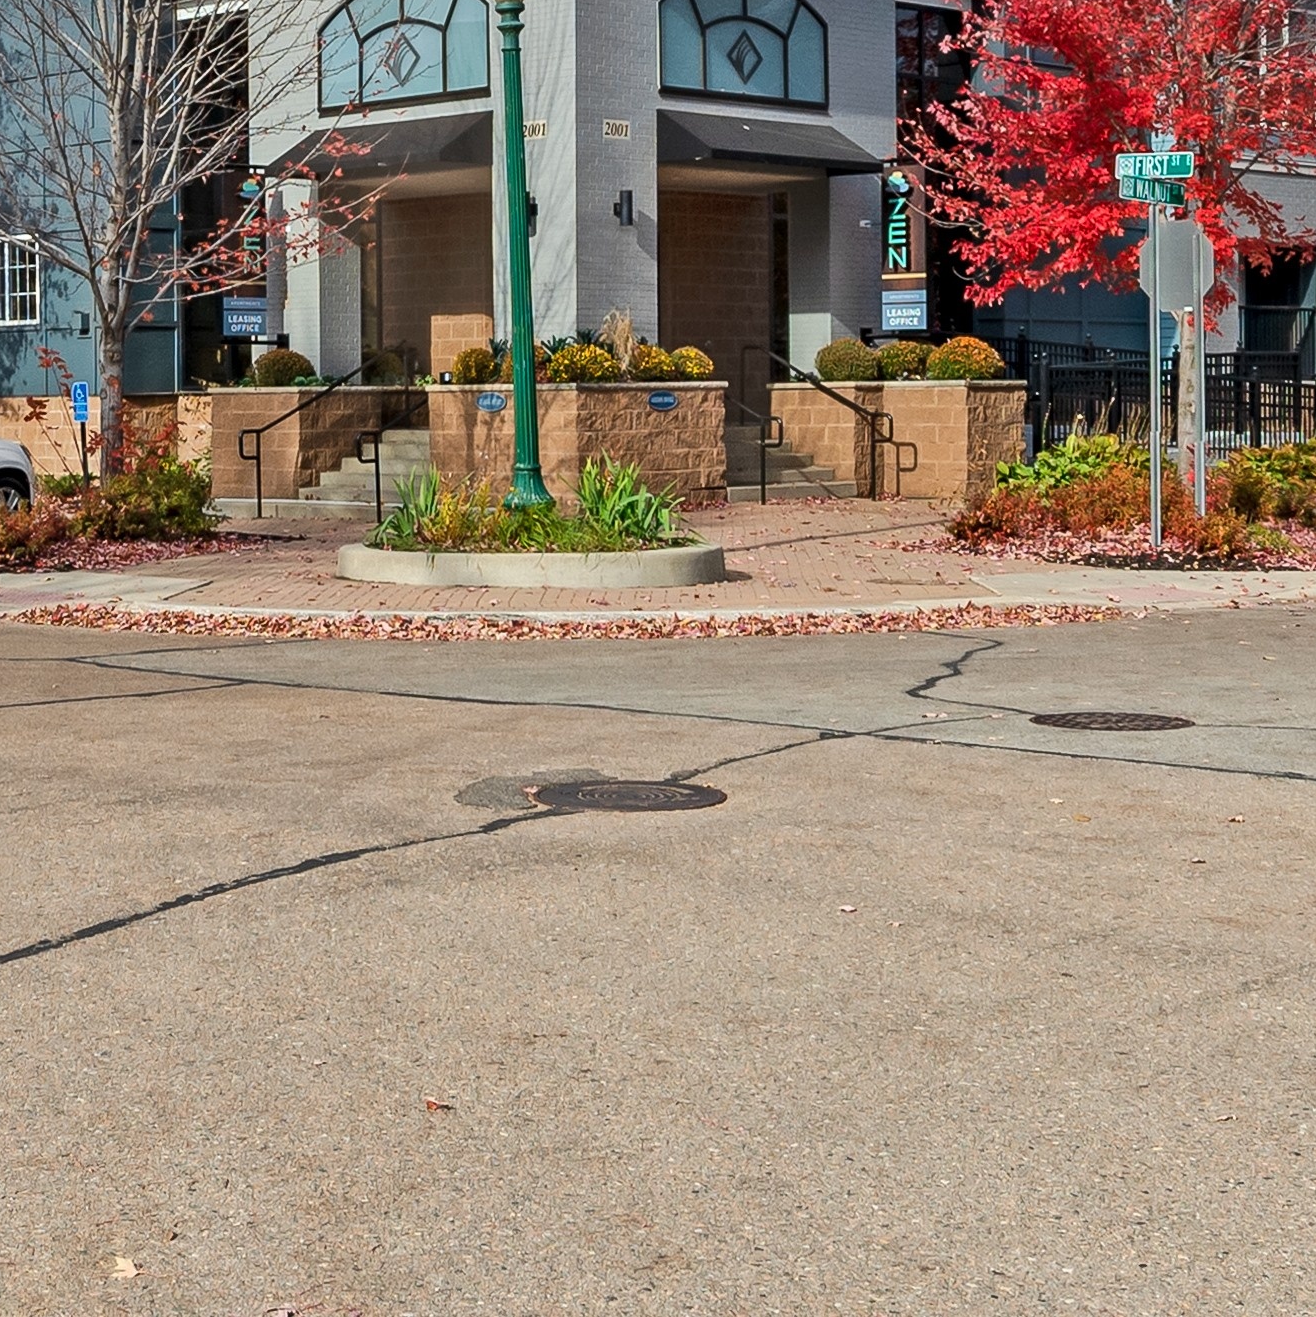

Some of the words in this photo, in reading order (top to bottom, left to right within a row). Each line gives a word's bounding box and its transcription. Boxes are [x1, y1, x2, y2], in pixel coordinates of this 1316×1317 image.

[522, 123, 546, 138] 2001
[604, 121, 629, 137] 2001
[1135, 155, 1169, 176] FIRST
[1171, 155, 1181, 166] ST
[1136, 178, 1171, 202] WALNUT
[888, 197, 907, 269] ZEN
[227, 315, 263, 323] LEASING
[886, 308, 921, 317] LEASING
[230, 324, 260, 332] OFFICE
[889, 317, 919, 326] OFFICE
